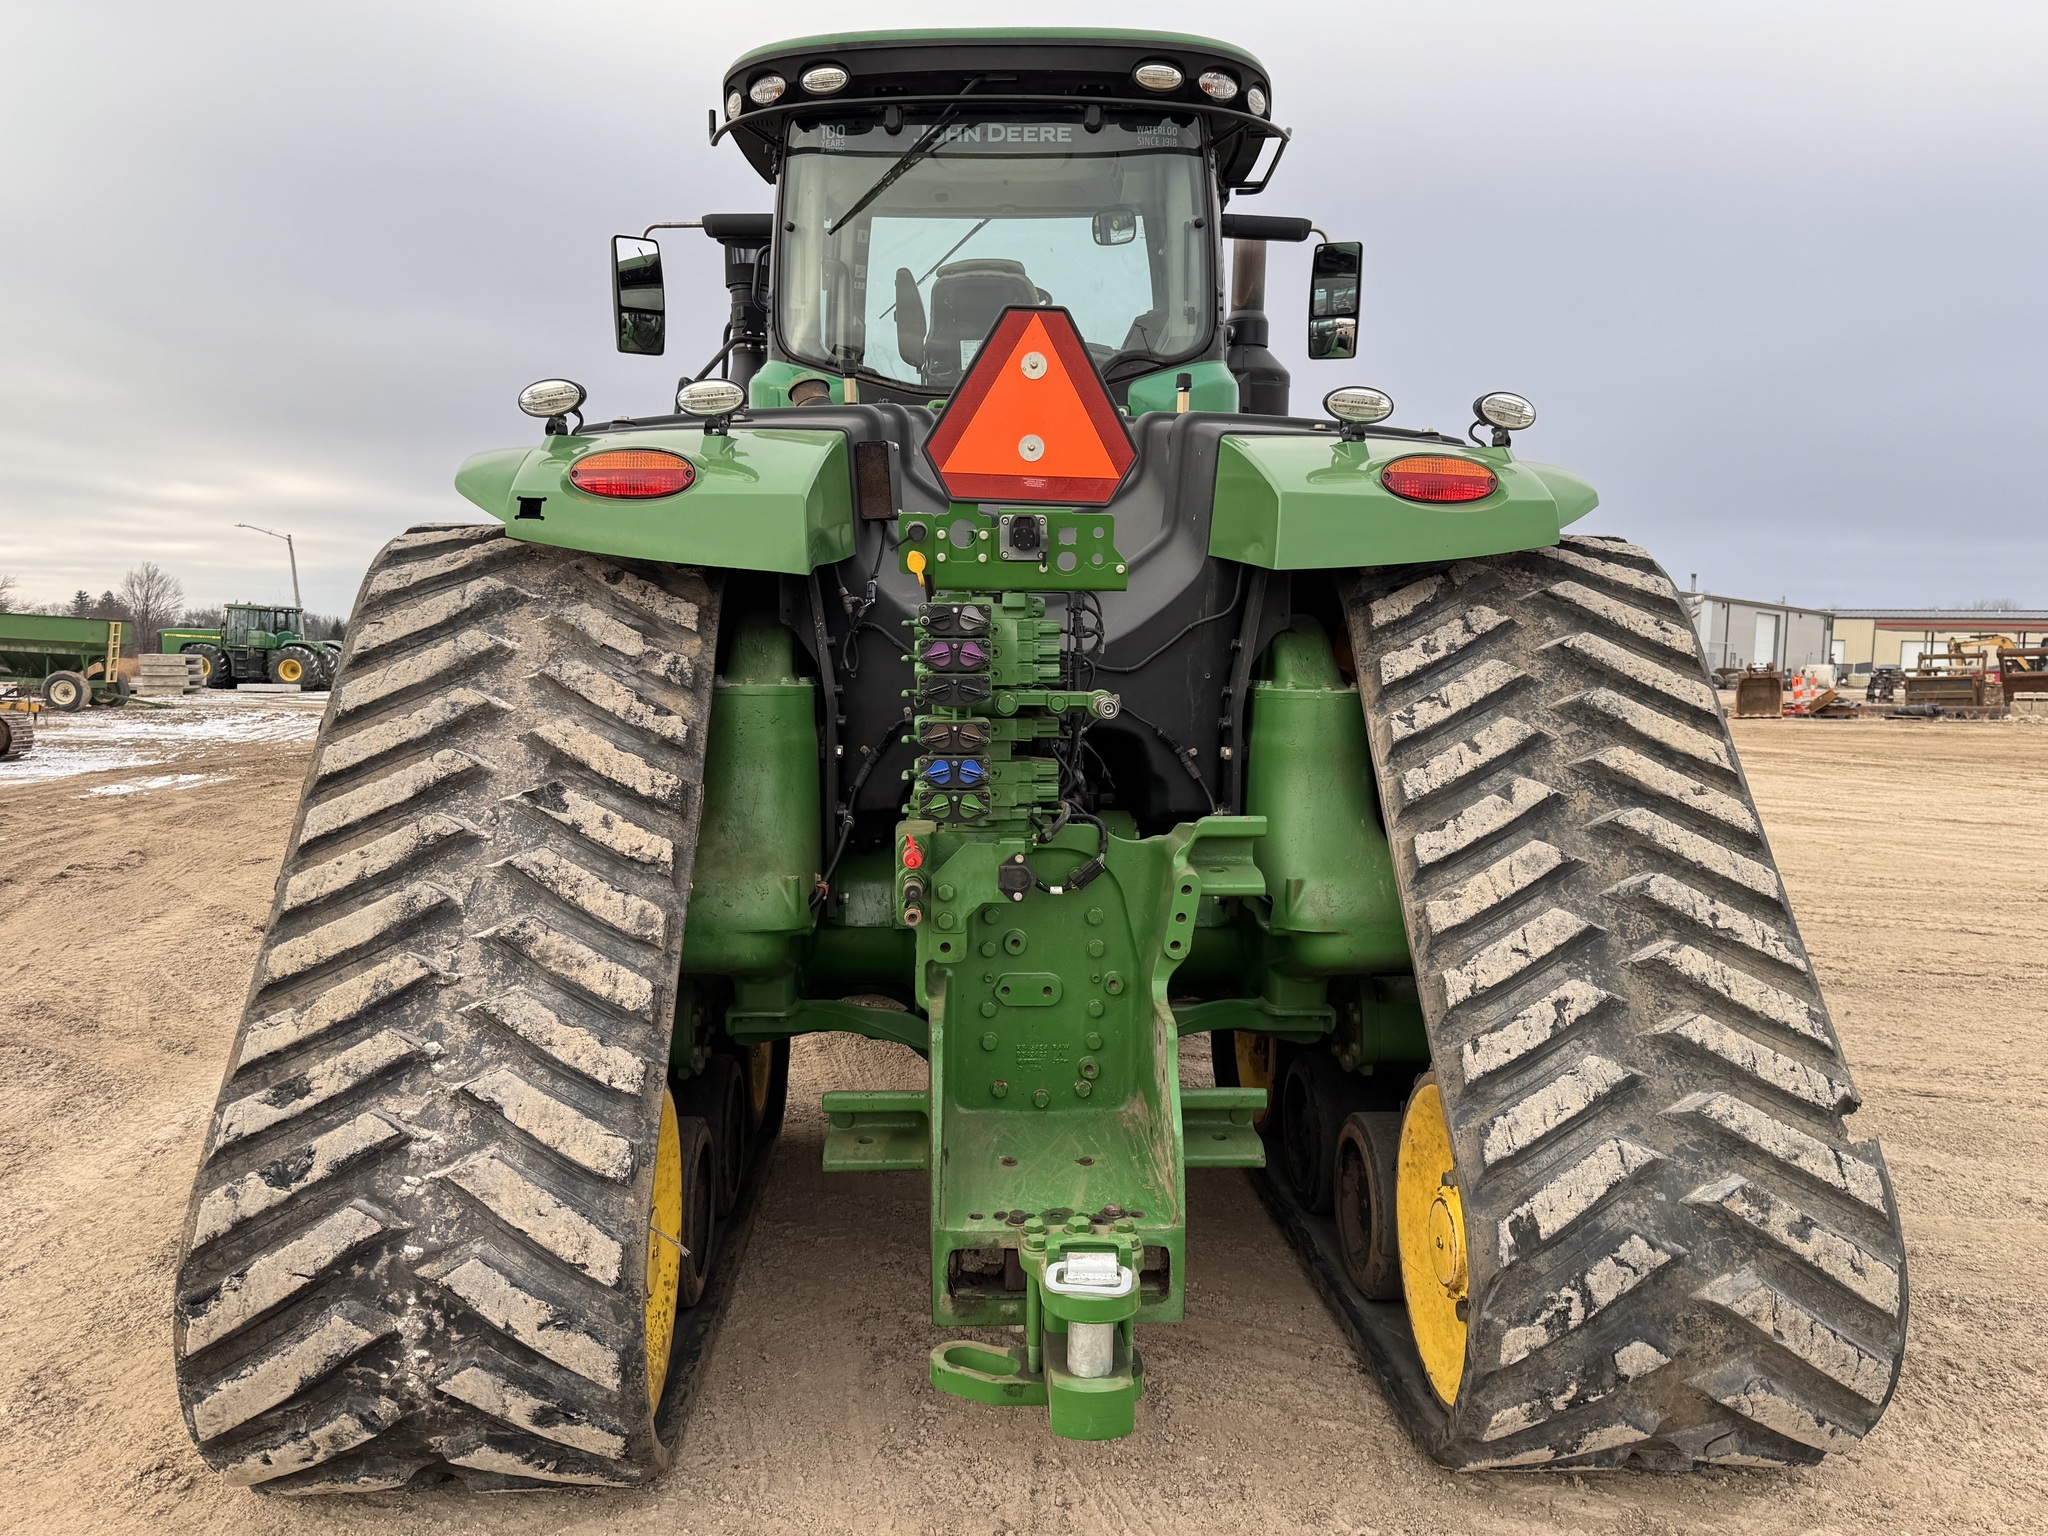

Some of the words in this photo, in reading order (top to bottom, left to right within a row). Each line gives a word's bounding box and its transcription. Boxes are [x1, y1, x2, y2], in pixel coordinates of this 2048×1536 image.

[820, 124, 845, 139] 100
[913, 124, 981, 143] JHN
[987, 123, 1072, 143] DEERE
[1136, 125, 1178, 136] WATERLOO
[820, 138, 846, 147] YEARS
[1137, 136, 1159, 146] SINCE
[1162, 137, 1178, 147] 1918
